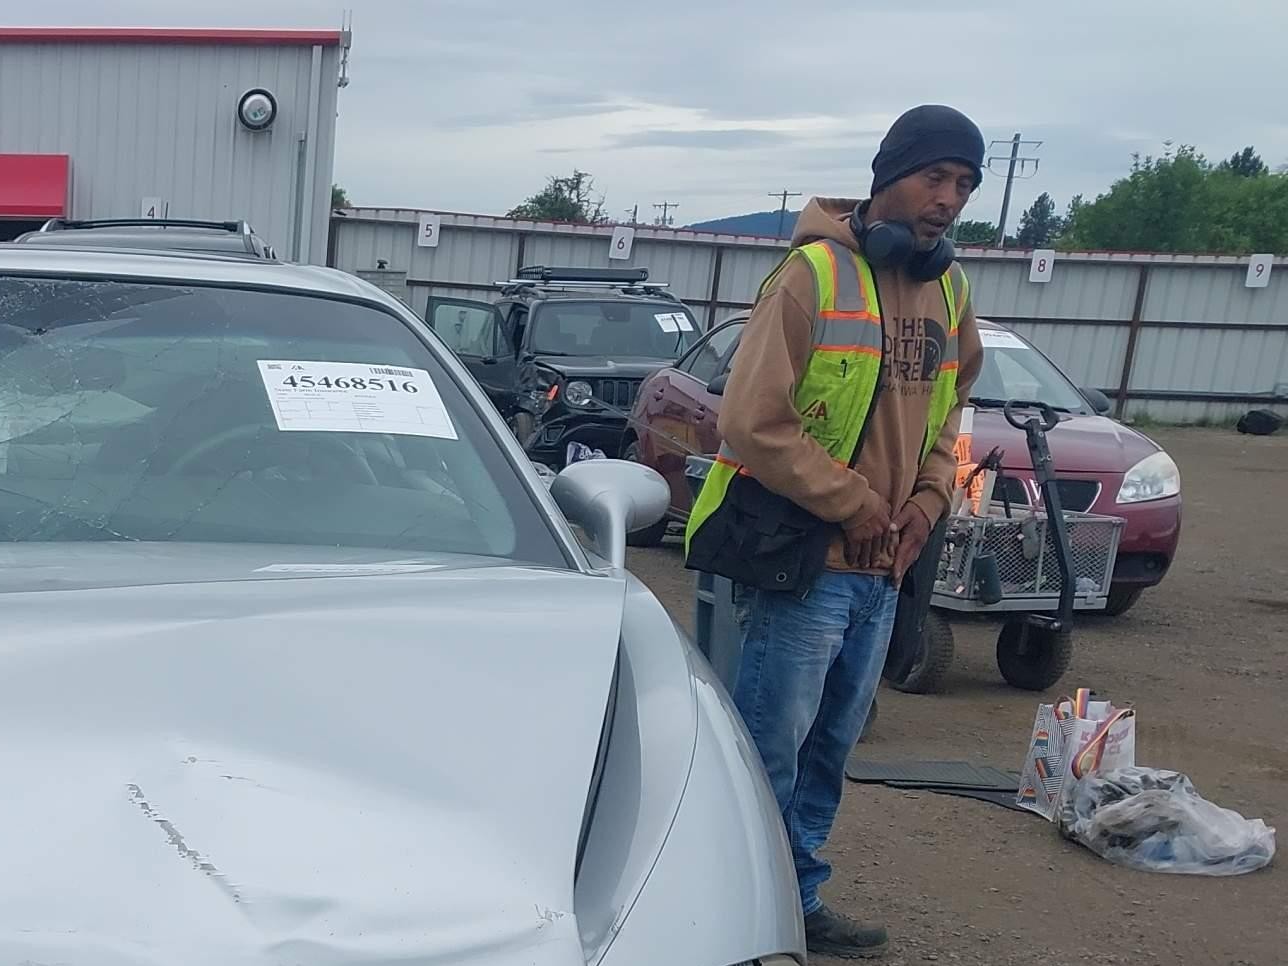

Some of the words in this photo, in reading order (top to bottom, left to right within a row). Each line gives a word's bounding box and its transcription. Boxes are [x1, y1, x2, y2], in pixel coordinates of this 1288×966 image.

[147, 205, 155, 219] 4
[425, 223, 433, 238] 5
[617, 236, 625, 250] 6
[1037, 259, 1047, 273] 8
[1255, 263, 1265, 278] 9
[282, 375, 419, 394] 45468516
